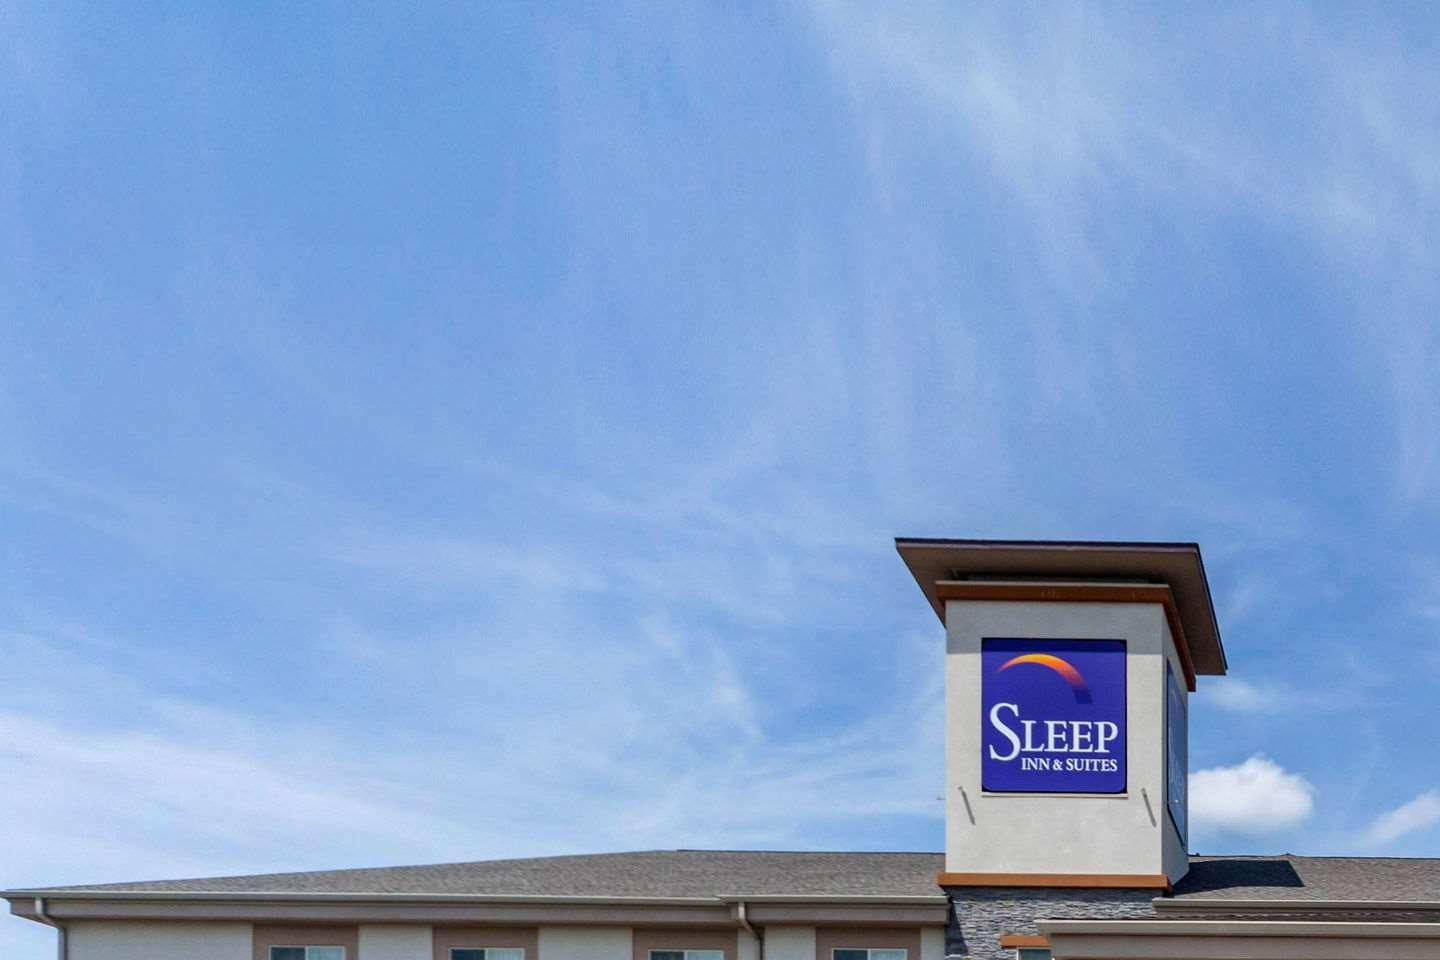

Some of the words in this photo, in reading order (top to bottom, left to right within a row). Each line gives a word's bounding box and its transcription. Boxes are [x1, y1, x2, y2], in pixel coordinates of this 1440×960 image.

[989, 702, 1119, 761] SLEEP
[1021, 757, 1050, 771] INN
[1052, 758, 1063, 771] &
[1065, 758, 1118, 772] SUITES
